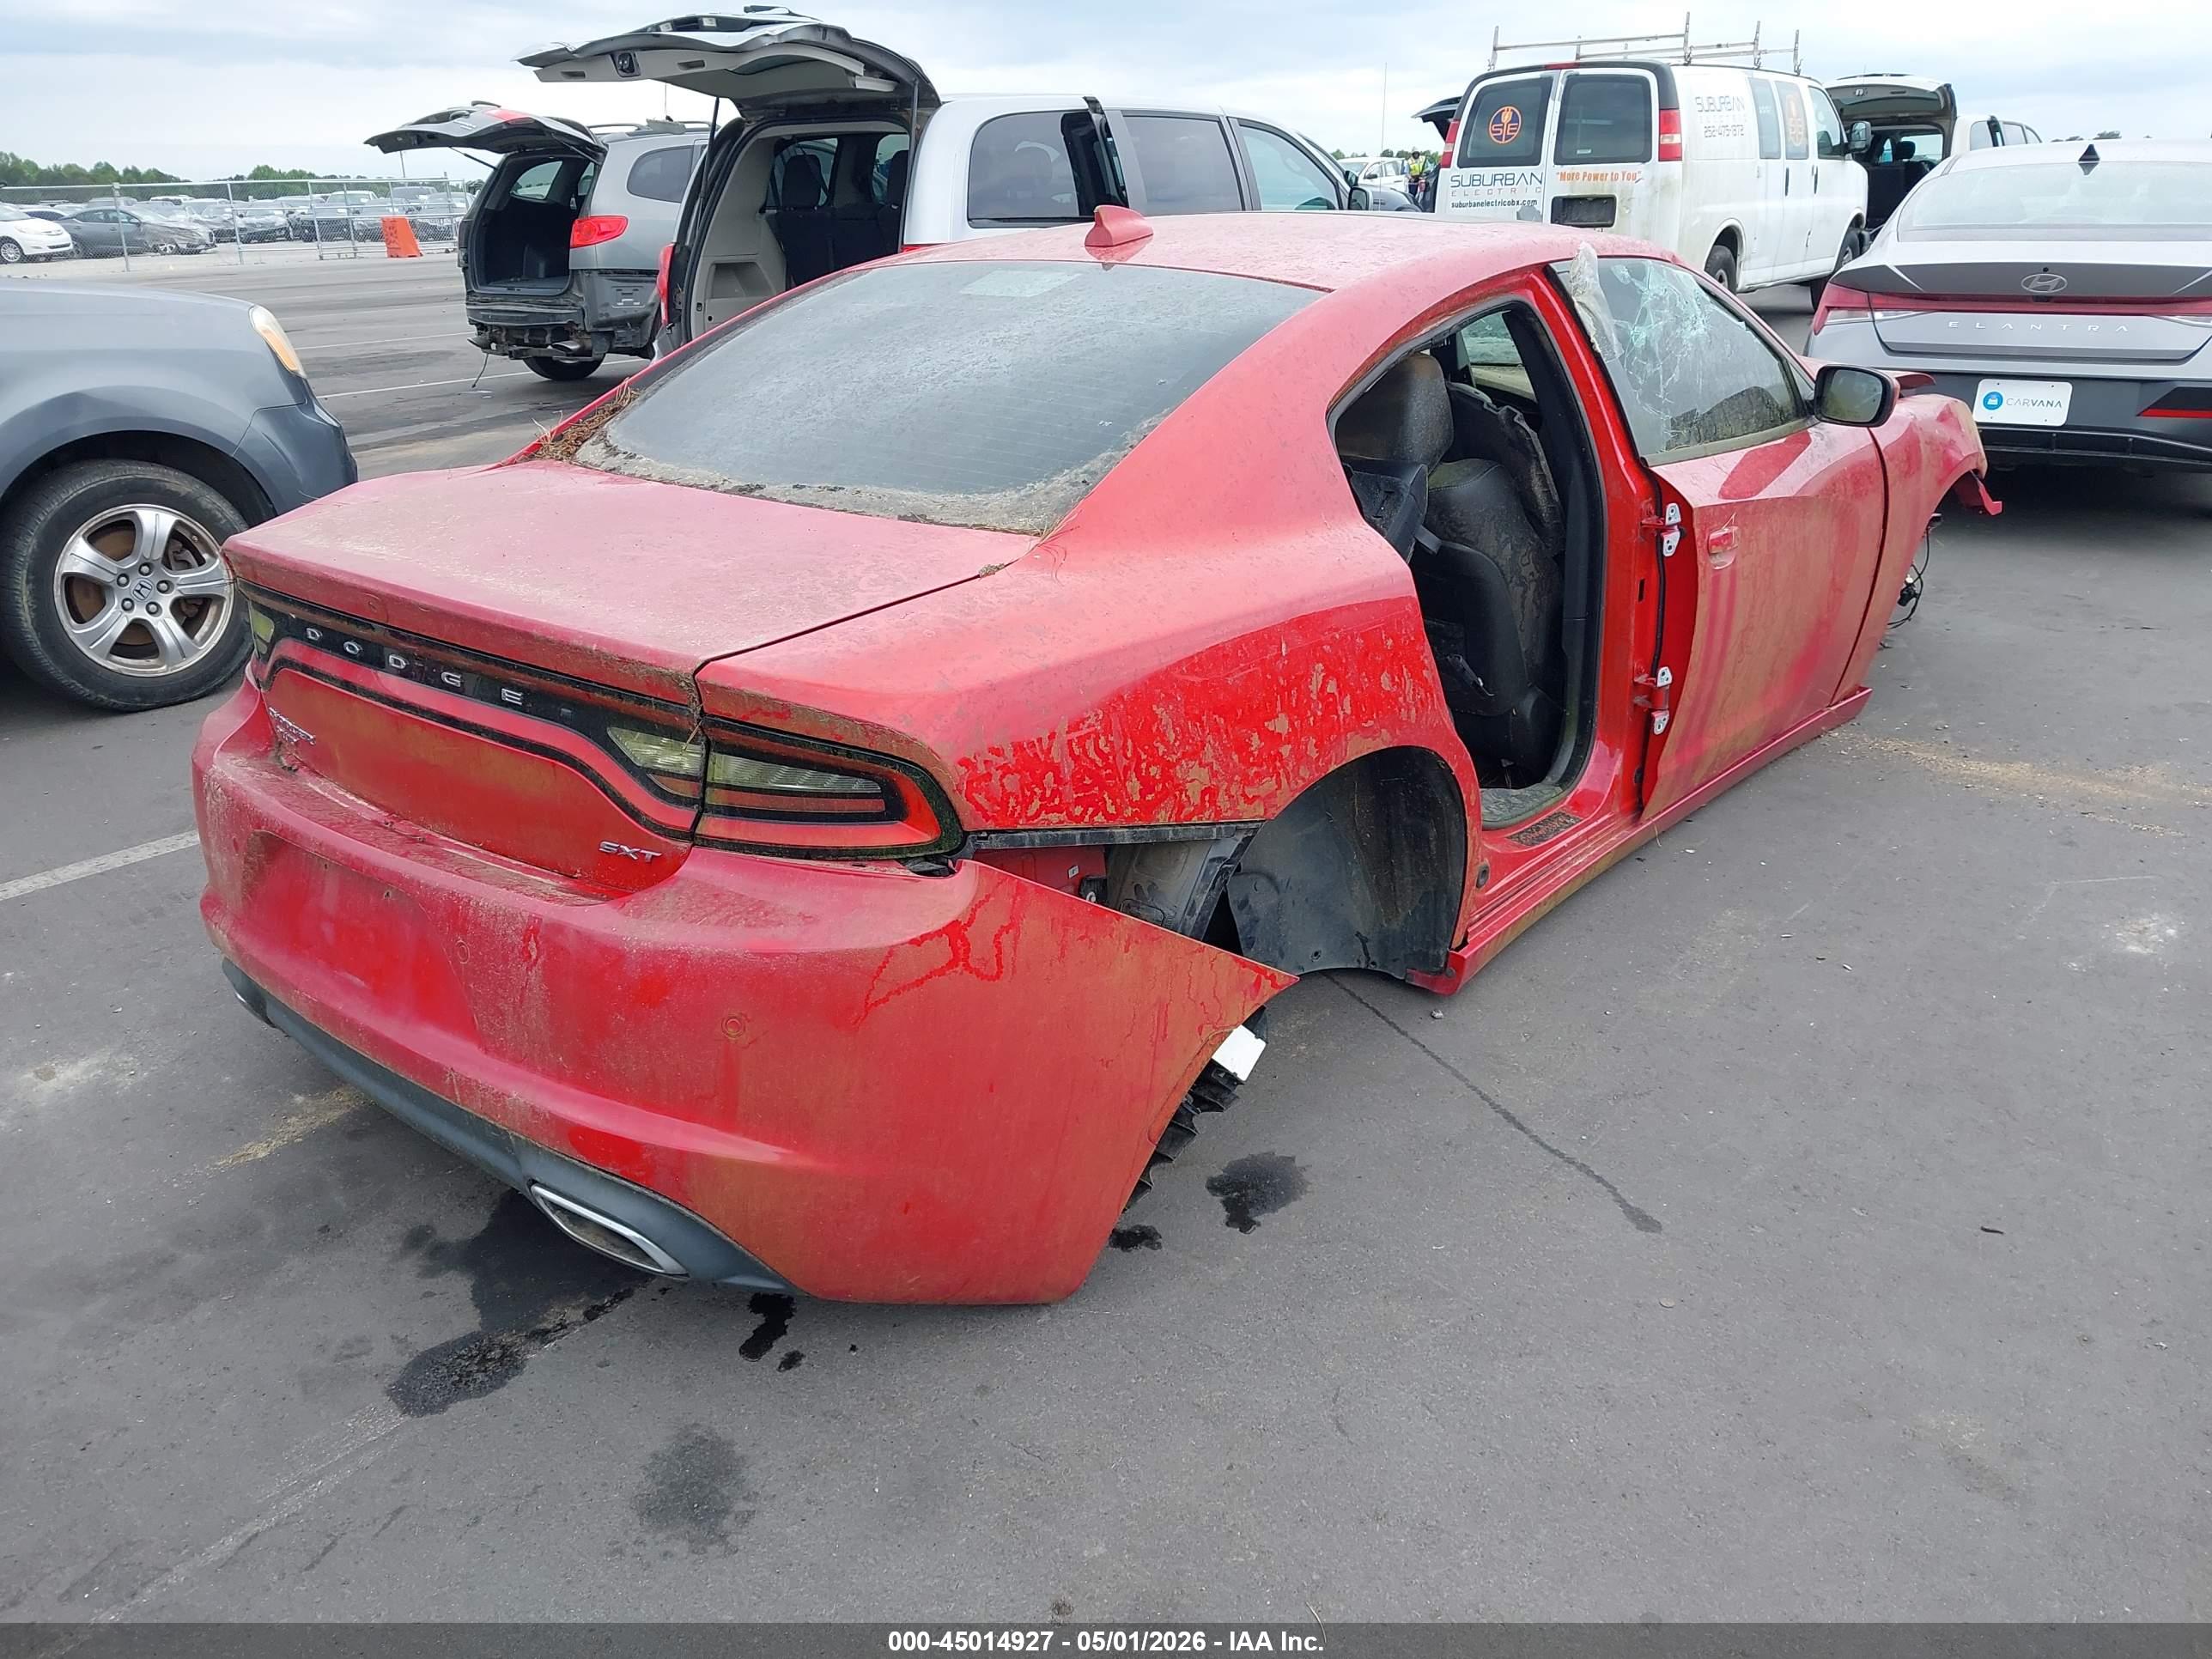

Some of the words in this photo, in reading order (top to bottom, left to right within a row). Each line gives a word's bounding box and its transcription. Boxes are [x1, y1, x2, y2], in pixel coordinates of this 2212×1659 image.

[1449, 171, 1544, 188] SUBURBAN
[1582, 171, 1609, 182] Power
[1610, 171, 1620, 181] to
[1450, 186, 1542, 197] ELECTRIC
[1450, 198, 1538, 208] suburbanelectricobx.com
[1948, 321, 2129, 332] ELANTRA
[2006, 398, 2063, 408] CARVANA
[305, 627, 524, 707] DODGE
[599, 841, 663, 863] SXT
